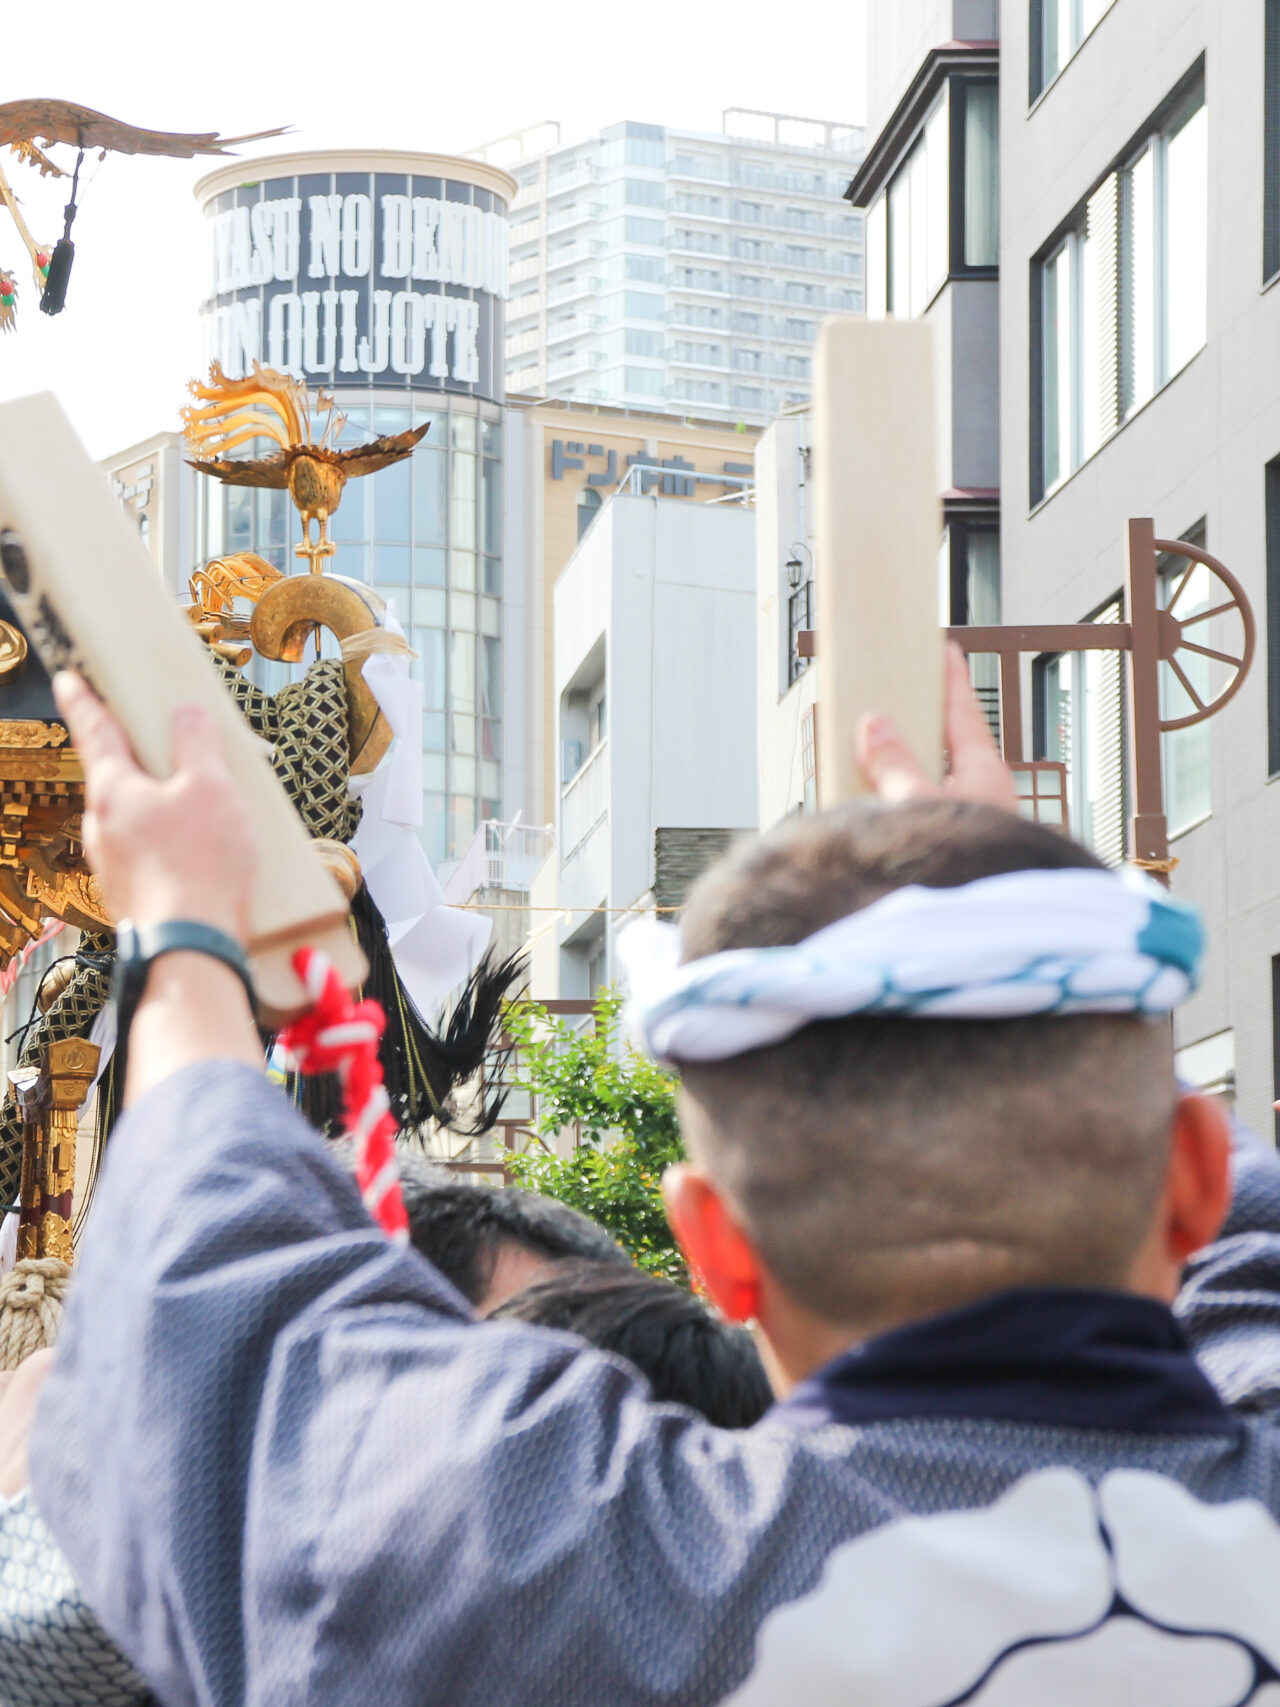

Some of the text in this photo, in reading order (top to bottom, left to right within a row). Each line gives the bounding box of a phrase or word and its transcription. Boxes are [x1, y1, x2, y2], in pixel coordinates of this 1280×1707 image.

[308, 194, 373, 278] NO
[205, 290, 479, 382] ON QUIJOTE
